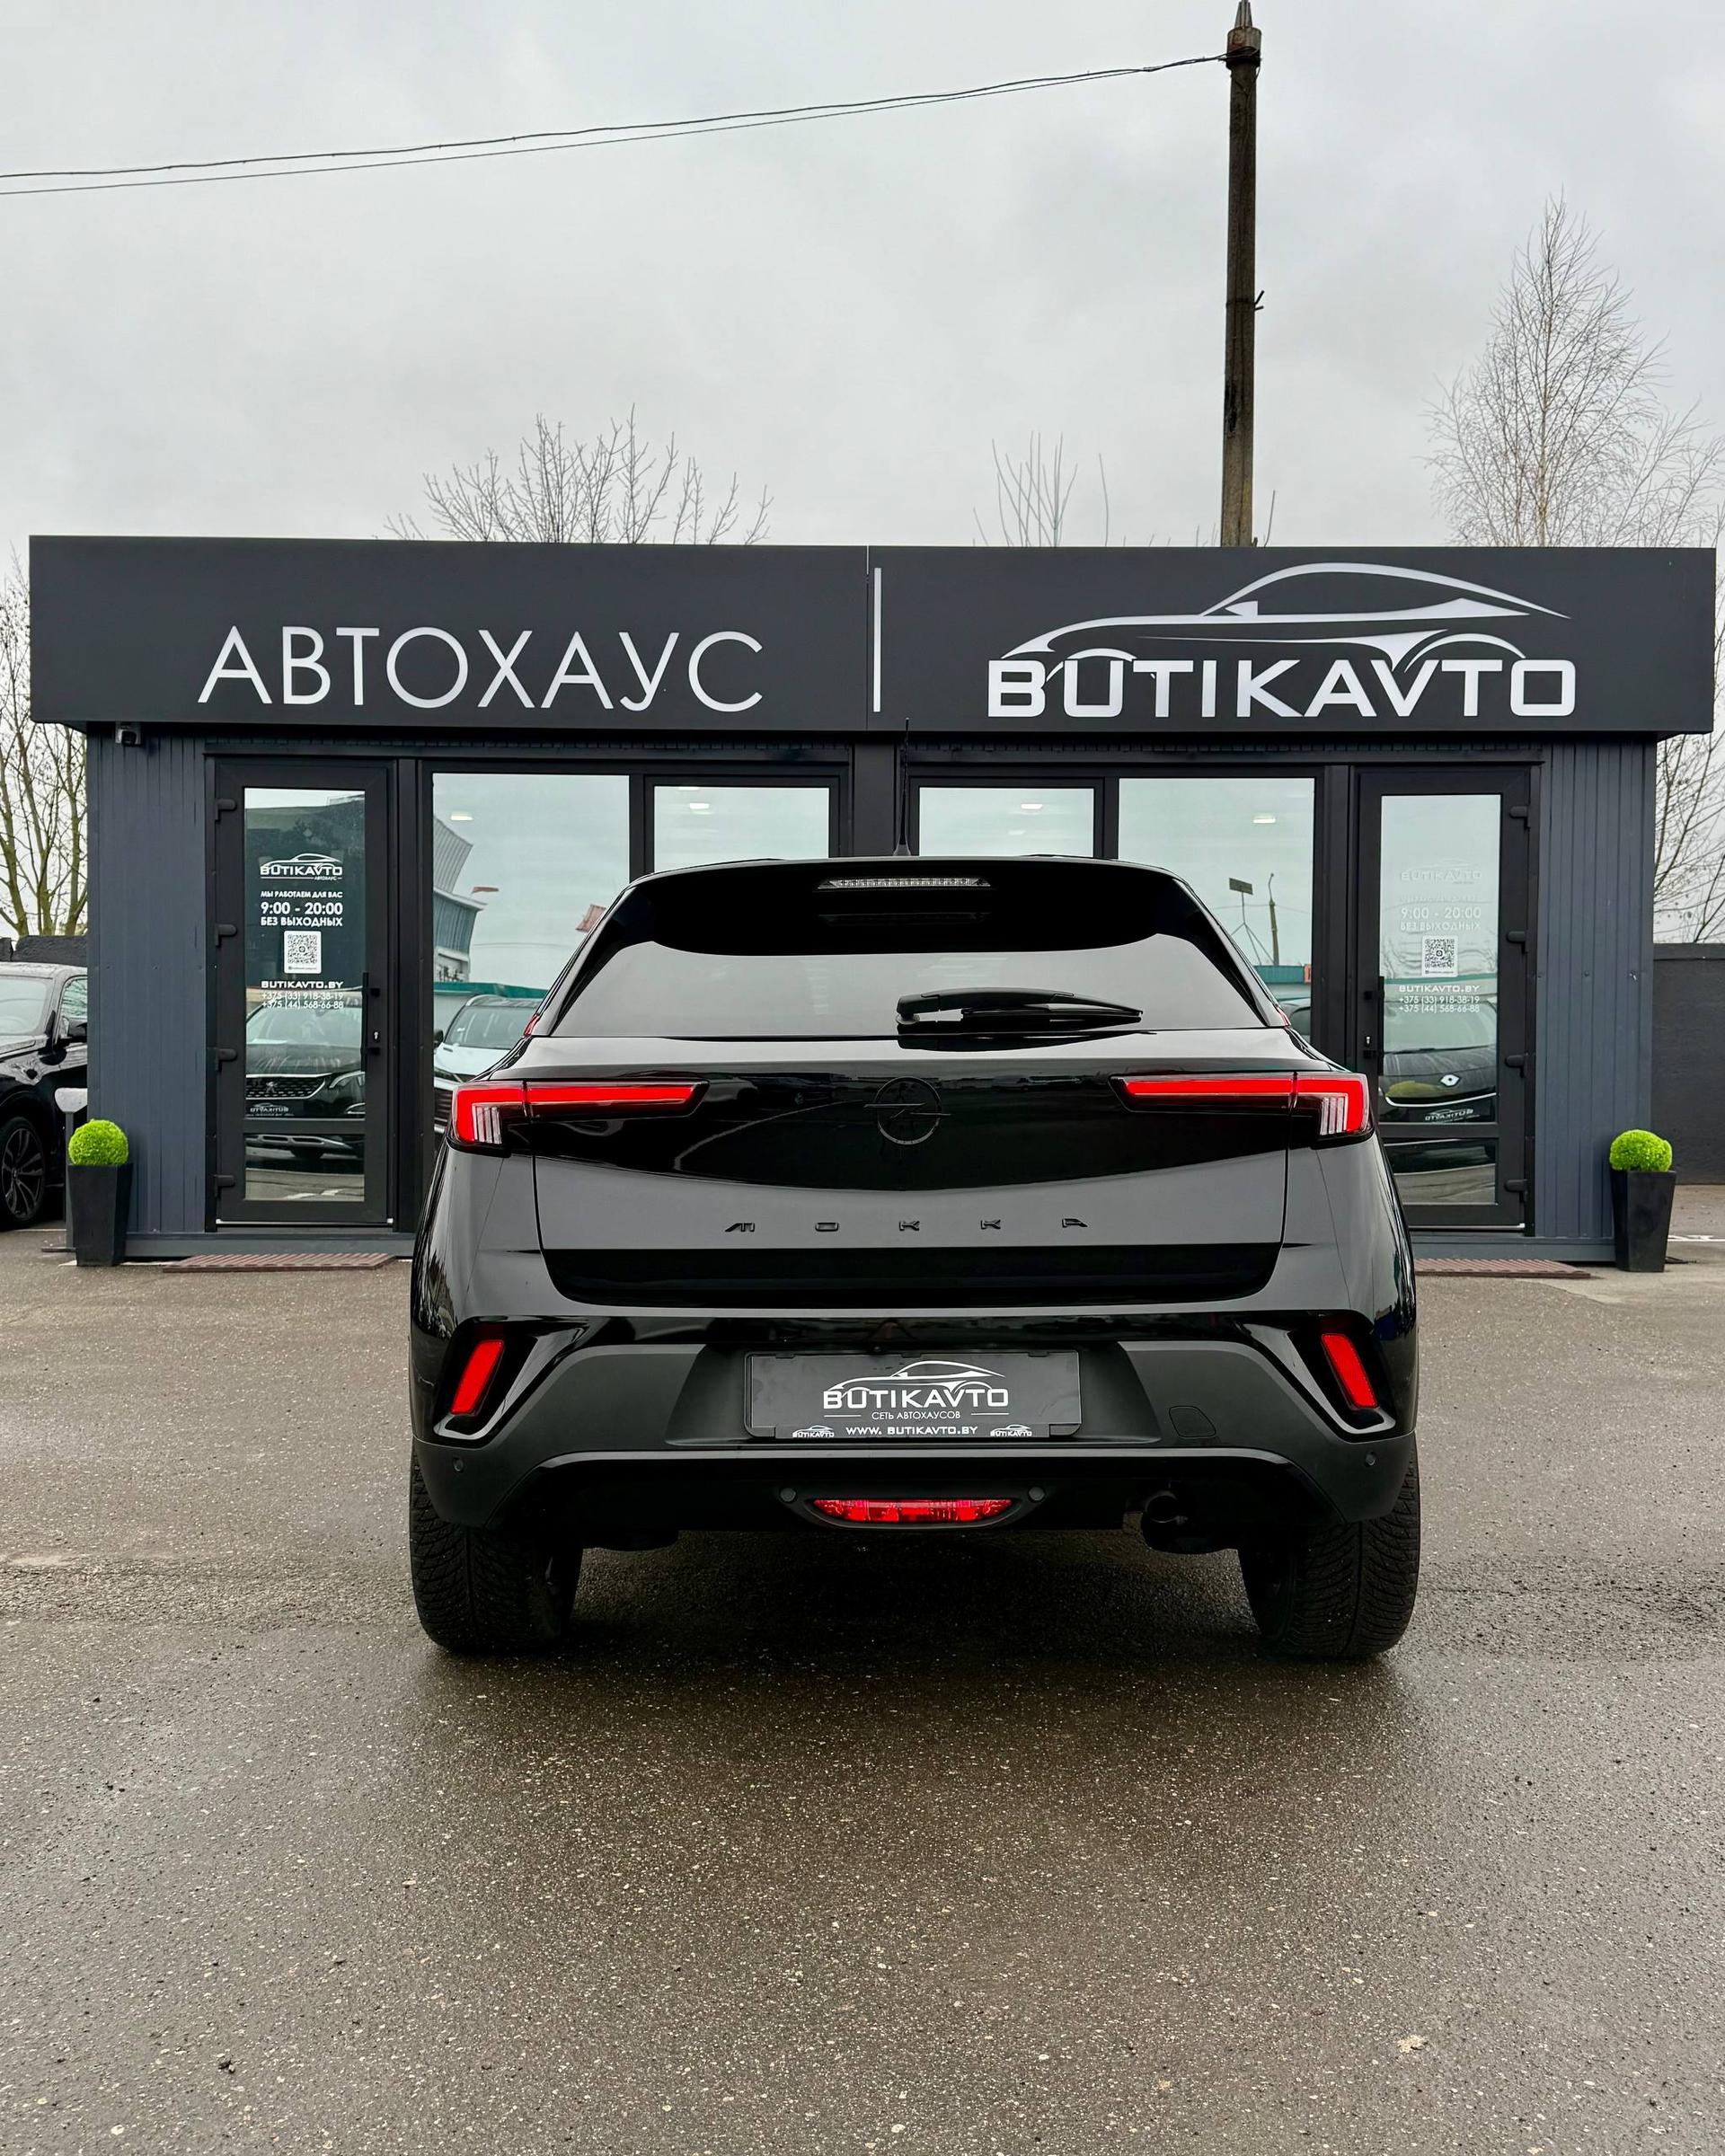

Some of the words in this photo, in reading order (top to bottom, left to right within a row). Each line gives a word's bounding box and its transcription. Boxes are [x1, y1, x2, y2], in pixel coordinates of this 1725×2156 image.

[199, 624, 764, 712] АВТОХАУС
[988, 658, 1577, 719] BUTIKAVTO
[260, 865, 343, 876] BUTIKAVTO
[261, 902, 291, 915] 9:00
[305, 902, 343, 915] 20:00
[1401, 907, 1429, 919] 9:00
[1445, 907, 1482, 919] 20:00
[261, 917, 279, 926] БЕЗ
[280, 917, 343, 927] ВЫХОДНЫХ
[261, 981, 343, 989] BUTIKAVTO.BY
[1399, 985, 1481, 993] BUTIKAVTO.BY
[261, 992, 283, 1000] +375
[1399, 996, 1420, 1004] +375
[1439, 996, 1481, 1004] 918-38-19
[261, 1001, 283, 1009] +375
[1399, 1004, 1420, 1012] +375
[725, 1217, 1088, 1233] MOKKA
[823, 1388, 1009, 1409] BUTIKAVTO
[871, 1411, 894, 1420] СЕТЬ
[897, 1411, 961, 1420] АВТОХАУСОВ
[845, 1427, 882, 1435] WWW.
[887, 1426, 978, 1435] BUTIKAVTO.BY
